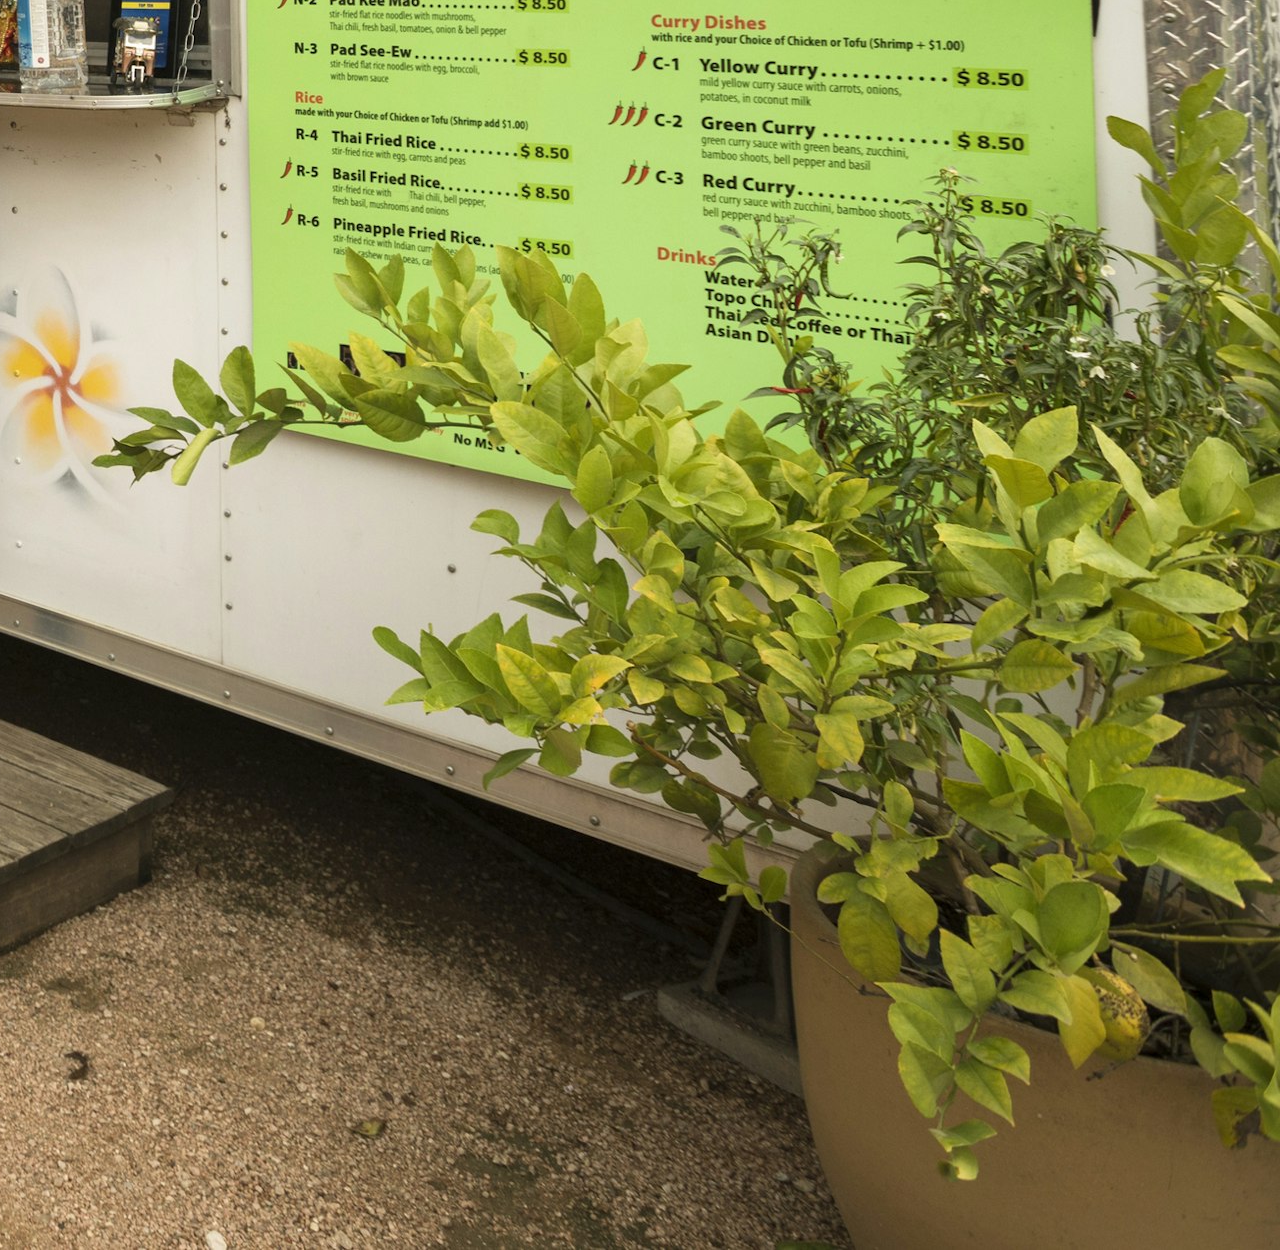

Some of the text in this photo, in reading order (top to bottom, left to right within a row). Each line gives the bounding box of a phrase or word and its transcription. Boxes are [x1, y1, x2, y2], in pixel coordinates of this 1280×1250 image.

[651, 14, 767, 32] Curry Dishes
[294, 42, 318, 54] N-3
[330, 44, 356, 56] Pad
[360, 44, 412, 58] See-Ew
[652, 57, 679, 71] C-1
[699, 58, 760, 74] Yellow
[764, 61, 818, 80] Curry
[296, 91, 324, 104] Rice
[296, 128, 318, 141] R-4
[332, 130, 362, 144] Thai
[366, 133, 402, 147] Fried
[406, 136, 436, 150] Rice
[702, 149, 871, 170] bamboo shoots, bell pepper and basil
[657, 246, 717, 267] Drinks
[704, 271, 756, 290] Water
[705, 289, 747, 309] Topo
[705, 306, 739, 323] Thai
[786, 316, 844, 336] Coffee
[847, 326, 866, 338] or
[870, 326, 912, 347] Thai
[705, 323, 752, 342] Asian
[454, 432, 471, 447] No
